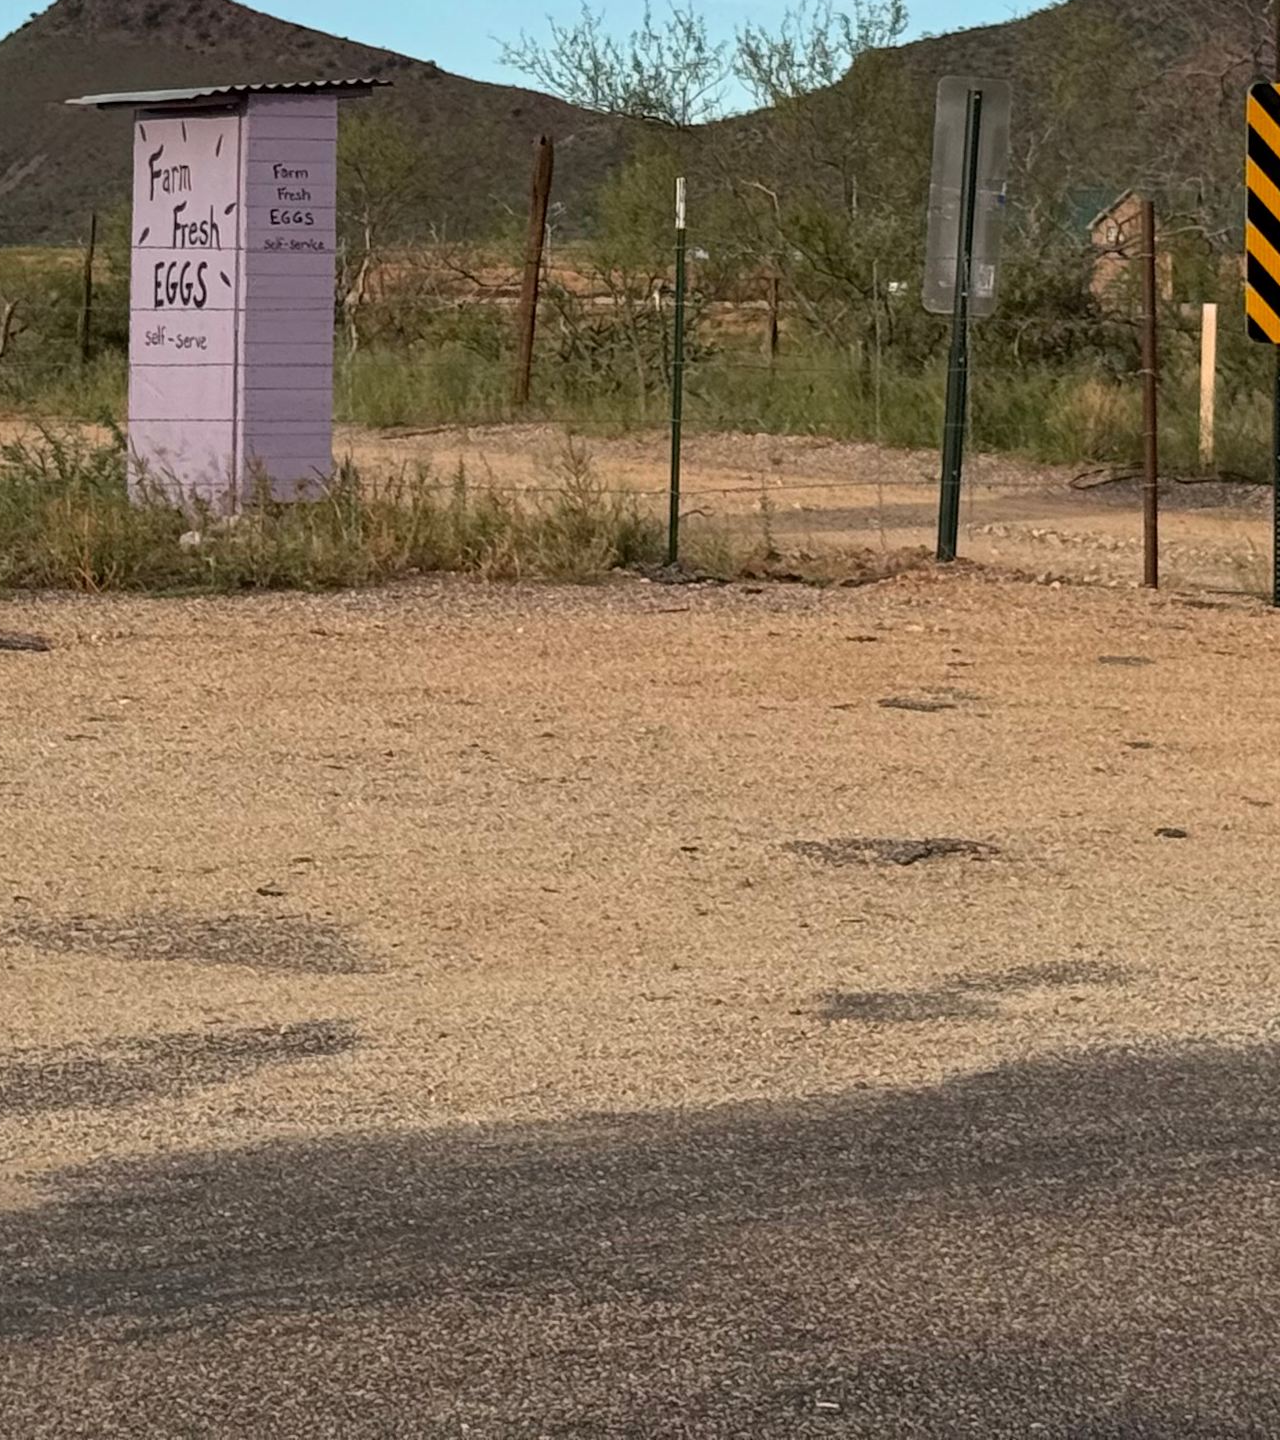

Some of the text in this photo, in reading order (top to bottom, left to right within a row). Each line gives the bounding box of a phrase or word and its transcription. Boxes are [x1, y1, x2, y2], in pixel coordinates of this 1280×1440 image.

[149, 144, 192, 201] Farm
[273, 163, 309, 179] Farm
[277, 187, 311, 201] Fresh
[173, 201, 221, 250] Fresh
[270, 208, 314, 225] EGGS
[154, 261, 208, 309] EGGS
[145, 324, 208, 350] self-serve
